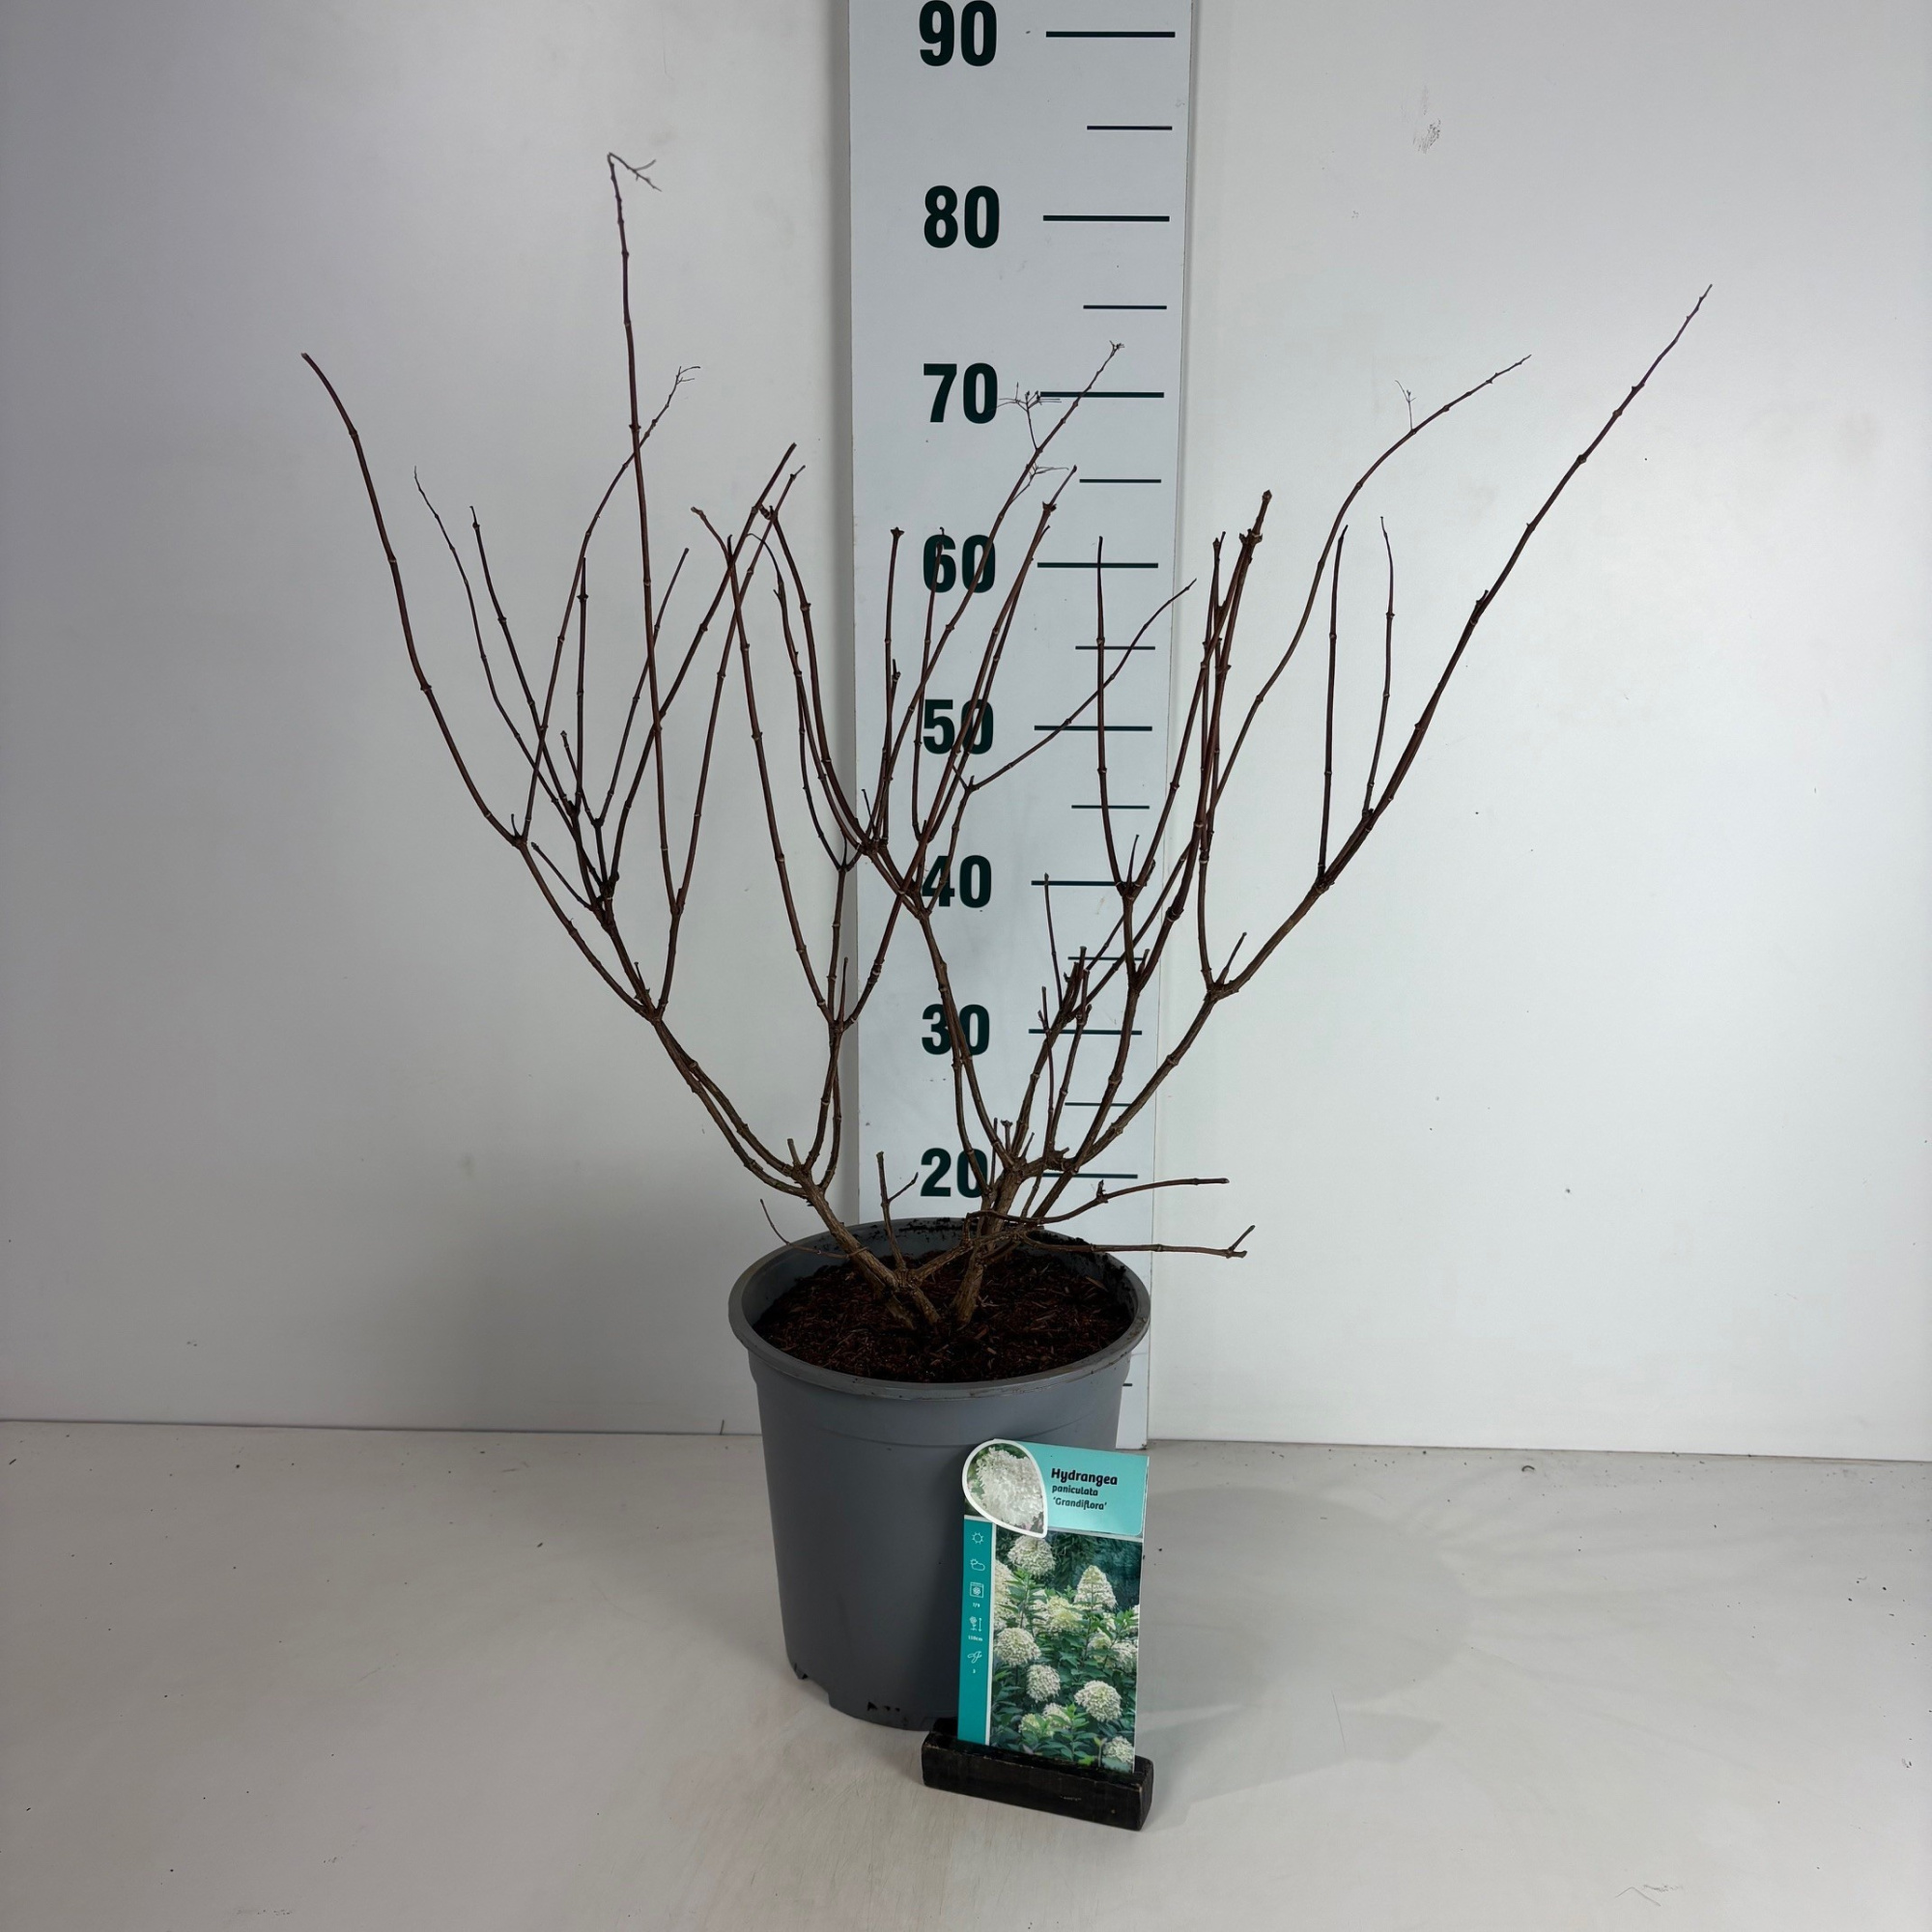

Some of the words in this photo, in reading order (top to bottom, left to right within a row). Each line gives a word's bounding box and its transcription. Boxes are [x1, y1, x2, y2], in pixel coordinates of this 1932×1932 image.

[919, 0, 998, 67] 90
[923, 185, 1000, 248] 80
[923, 363, 998, 424] 70
[923, 534, 996, 593] 60
[923, 698, 994, 754] 50
[922, 855, 992, 908] 40
[922, 1004, 990, 1056] 30
[921, 1148, 988, 1199] 20
[1051, 1467, 1118, 1488] Hydrangea
[1052, 1485, 1098, 1496] paniculata
